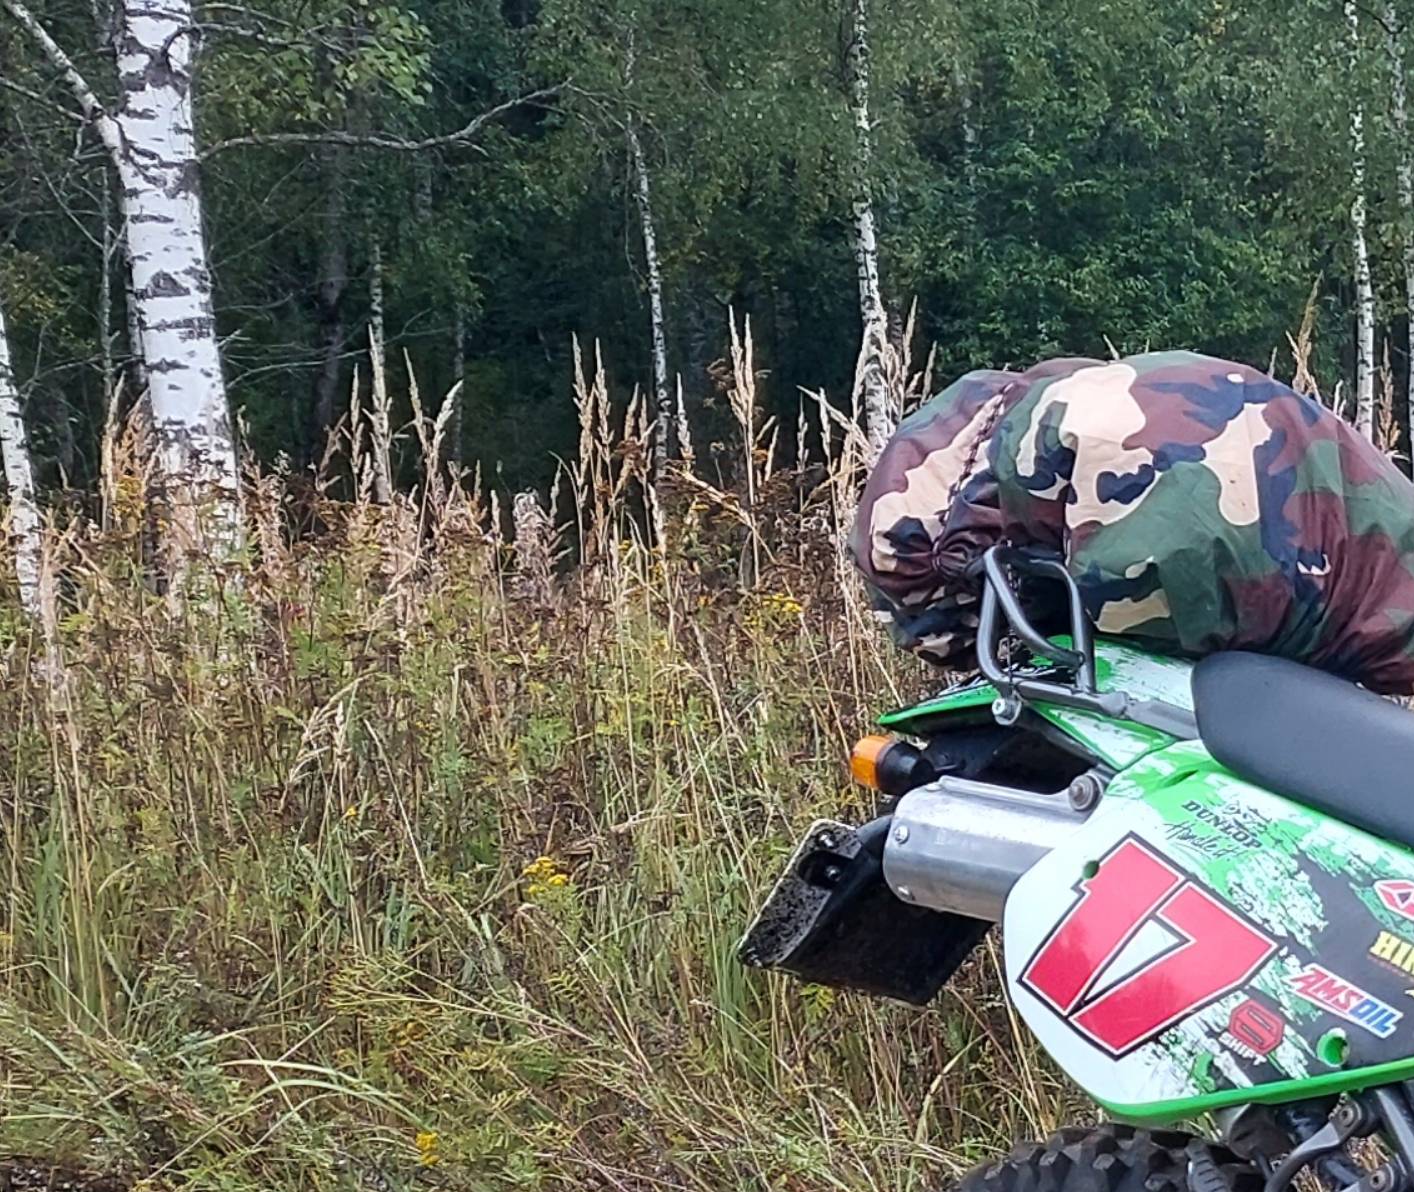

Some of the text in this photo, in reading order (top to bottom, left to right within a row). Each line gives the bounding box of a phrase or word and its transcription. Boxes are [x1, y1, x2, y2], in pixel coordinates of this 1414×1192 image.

[1181, 800, 1262, 848] DUNLOP
[1018, 832, 1282, 1059] 17
[1287, 965, 1402, 1036] AMSOIL
[1218, 1031, 1267, 1065] SHIFT
